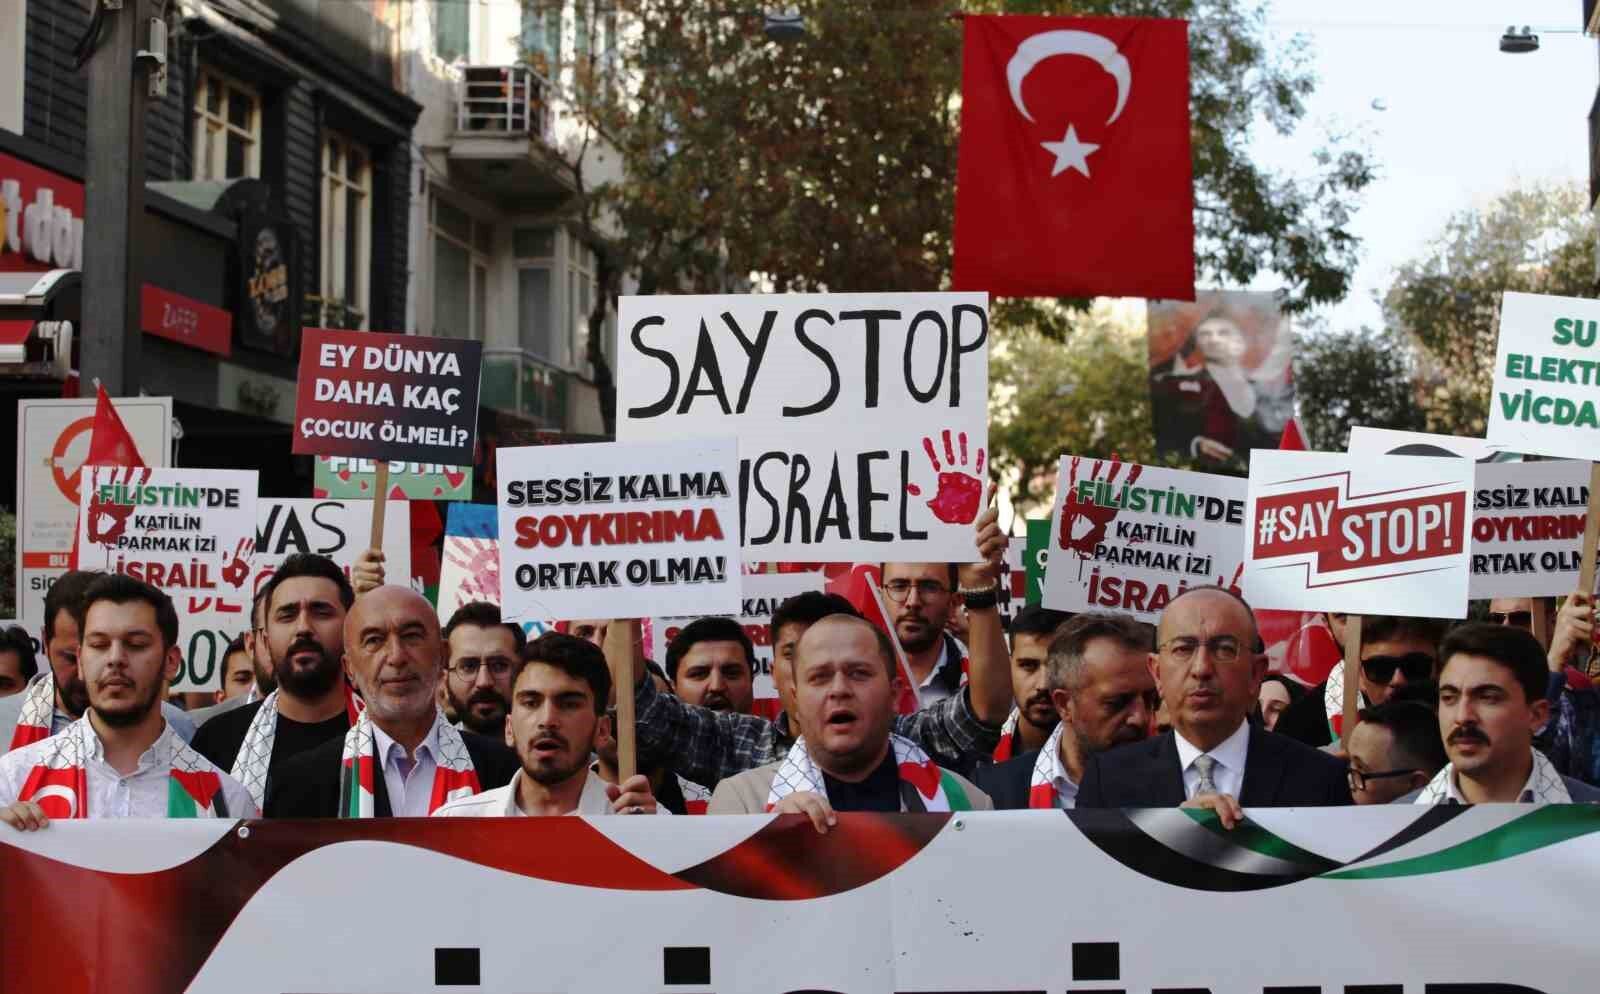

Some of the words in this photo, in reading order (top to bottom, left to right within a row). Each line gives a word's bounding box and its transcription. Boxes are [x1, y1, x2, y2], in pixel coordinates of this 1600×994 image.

[1552, 317, 1598, 348] SU
[319, 343, 357, 368] EY
[363, 343, 462, 377] DÜNYA
[627, 310, 778, 418] SAY
[782, 304, 988, 417] STOP
[314, 378, 396, 407] DAHA
[402, 384, 461, 416] KAÇ
[1499, 389, 1600, 429] VİCDA
[300, 418, 375, 440] ÇOCUK
[379, 420, 469, 448] ÖLMELİ?
[99, 482, 240, 508] FİLİSTİN'DE
[507, 472, 613, 507] SESSİZ
[618, 472, 729, 501] KALMA
[738, 450, 928, 547] ISRAEL
[1077, 476, 1247, 525] FİLİSTİN'DE
[1473, 484, 1529, 510] SSİZ
[134, 512, 201, 531] KATİLİN
[515, 508, 725, 549] SOYKIRIMA
[1116, 521, 1197, 547] KATİLİN
[1259, 500, 1335, 545] #SAY
[1341, 502, 1453, 561] STOP!
[118, 535, 189, 552] PARMAK
[194, 535, 216, 552] İZİ
[1094, 544, 1180, 571] PARMAK
[1185, 552, 1212, 575] İZİ
[116, 556, 217, 588] İSRAİL
[515, 560, 622, 591] ORTAK
[626, 556, 728, 586] OLMA!
[1470, 553, 1537, 575] RTAK
